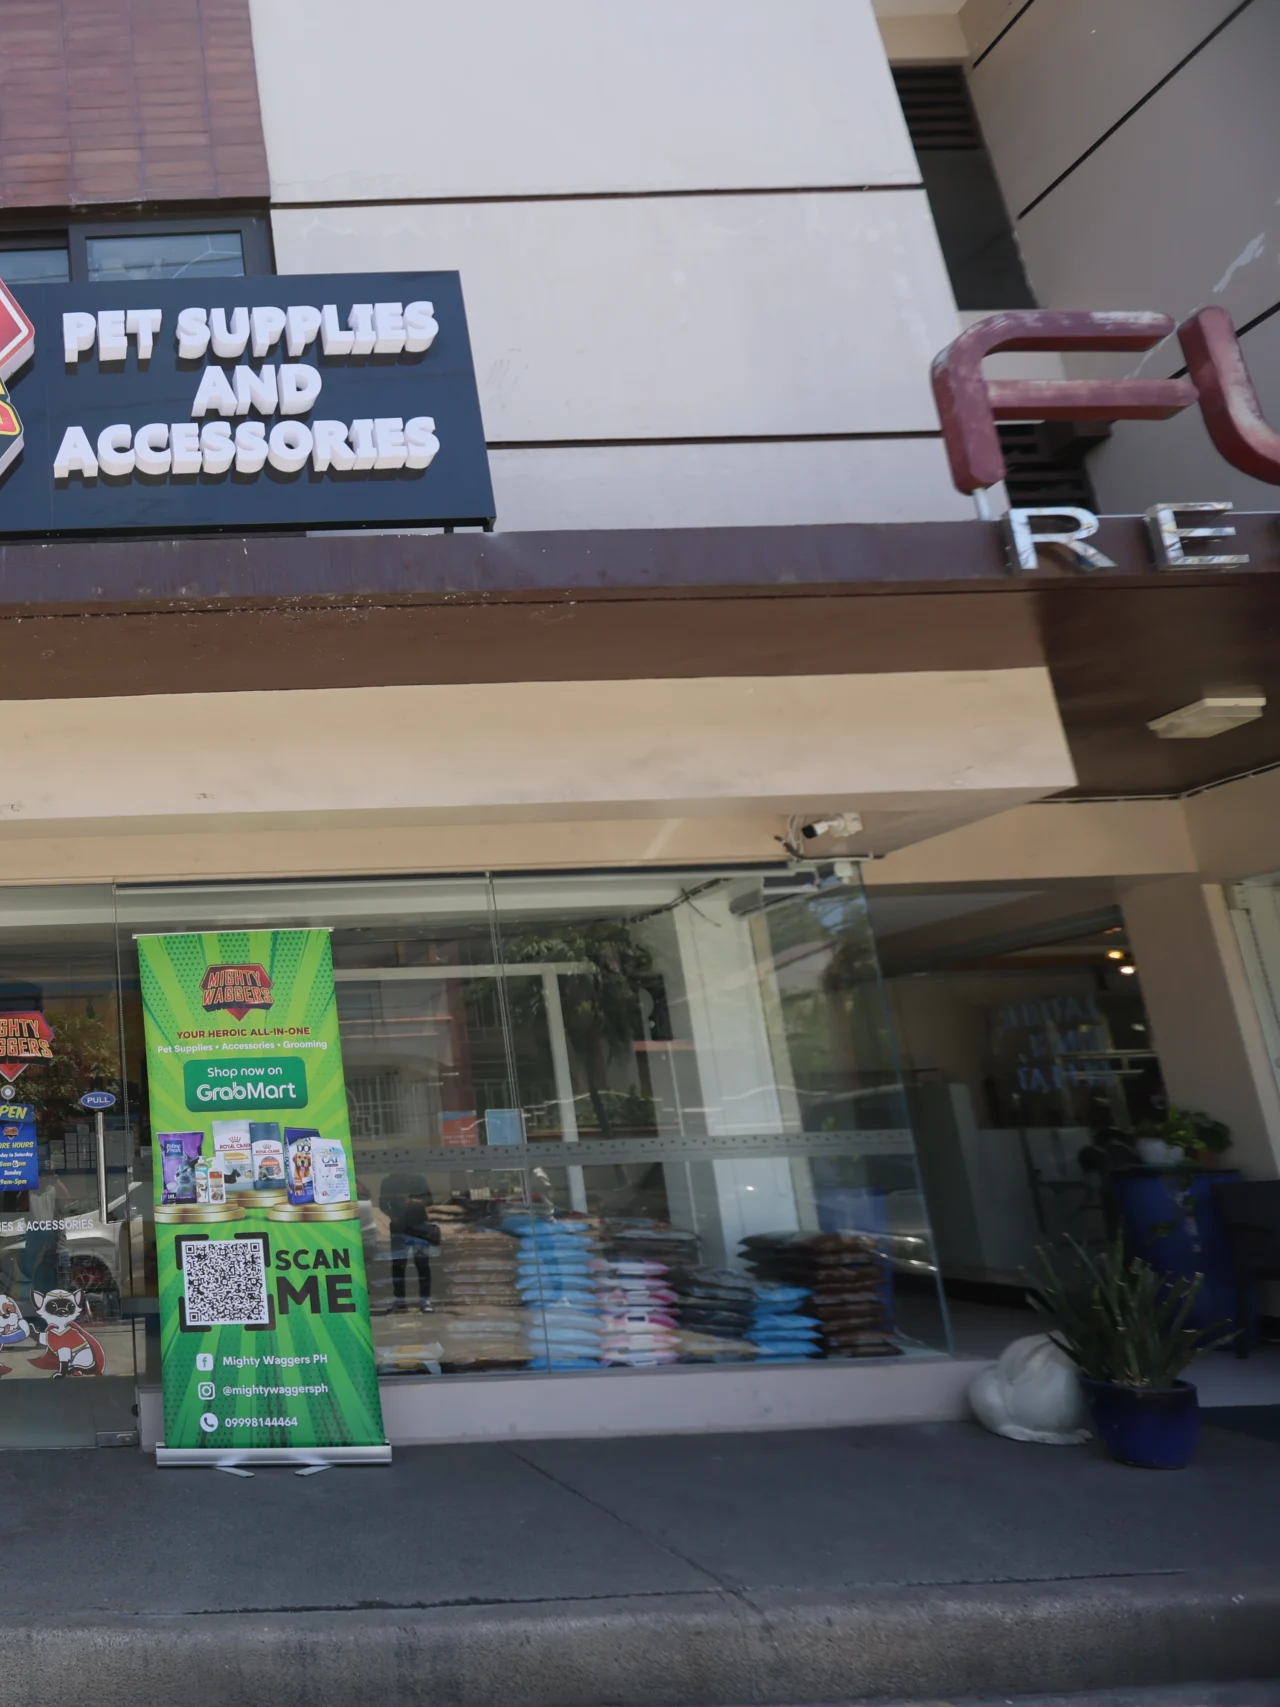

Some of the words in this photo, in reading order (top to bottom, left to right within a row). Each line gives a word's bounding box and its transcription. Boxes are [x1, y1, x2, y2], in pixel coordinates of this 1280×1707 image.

[63, 309, 162, 363] PET
[175, 301, 439, 359] SUPPLIES
[191, 363, 322, 417] AND
[53, 416, 440, 478] ACCESSORIES
[207, 969, 262, 988] MIGHTY
[202, 986, 273, 1006] WAGGERS
[176, 1031, 205, 1040] YOUR
[208, 1028, 247, 1038] HEROIC
[250, 1027, 310, 1037] ALL-IN-ONE
[157, 1044, 172, 1054] Pet
[174, 1043, 213, 1054] Supplies
[222, 1041, 275, 1051] Accessories
[283, 1040, 327, 1051] Grooming
[207, 1067, 238, 1078] Shop
[240, 1067, 265, 1076] now
[267, 1066, 283, 1076] on
[196, 1081, 296, 1102] GrabMart
[87, 1096, 110, 1104] PULL
[12, 1141, 34, 1149] HOURS
[26, 1219, 94, 1232] ACCESSORIES
[275, 1248, 351, 1271] SCAN
[276, 1274, 356, 1315] ME
[222, 1355, 260, 1368] Mighty
[263, 1354, 310, 1368] Waggers
[313, 1354, 328, 1364] PH
[222, 1383, 328, 1397] @mightywaggersph
[225, 1417, 298, 1428] 09998144464
